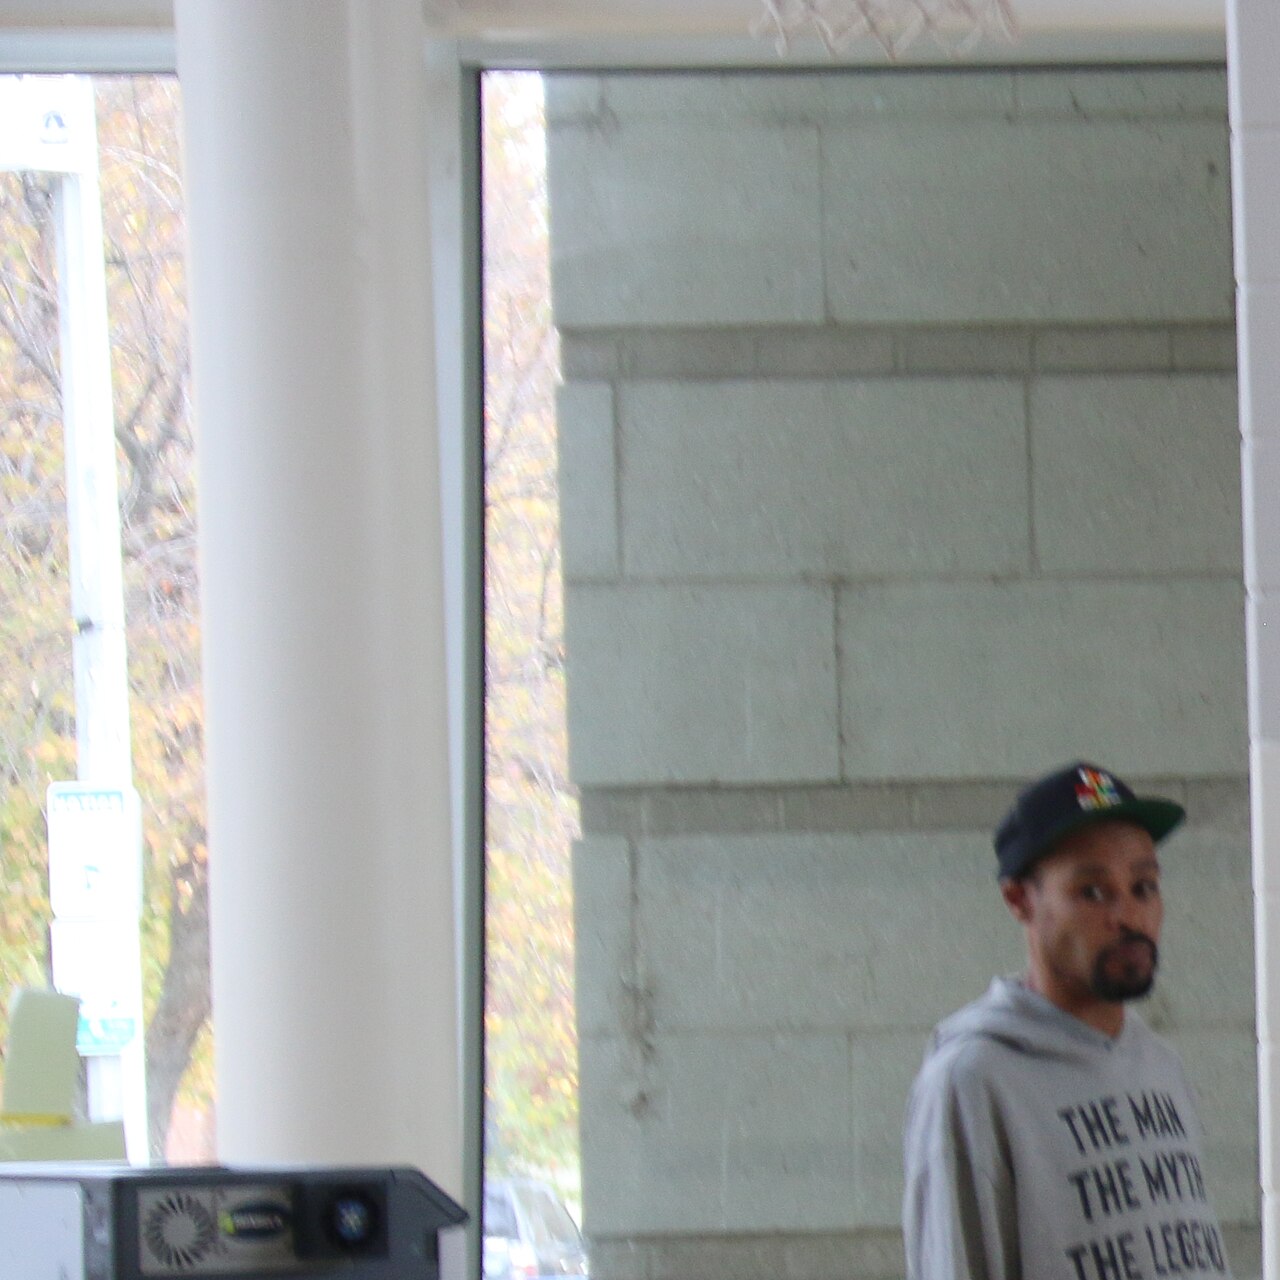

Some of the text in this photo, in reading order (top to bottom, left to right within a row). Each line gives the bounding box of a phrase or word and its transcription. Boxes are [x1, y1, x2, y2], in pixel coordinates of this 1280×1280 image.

[1057, 1090, 1187, 1155] THE MAN
[1067, 1150, 1206, 1223] THE MYTH
